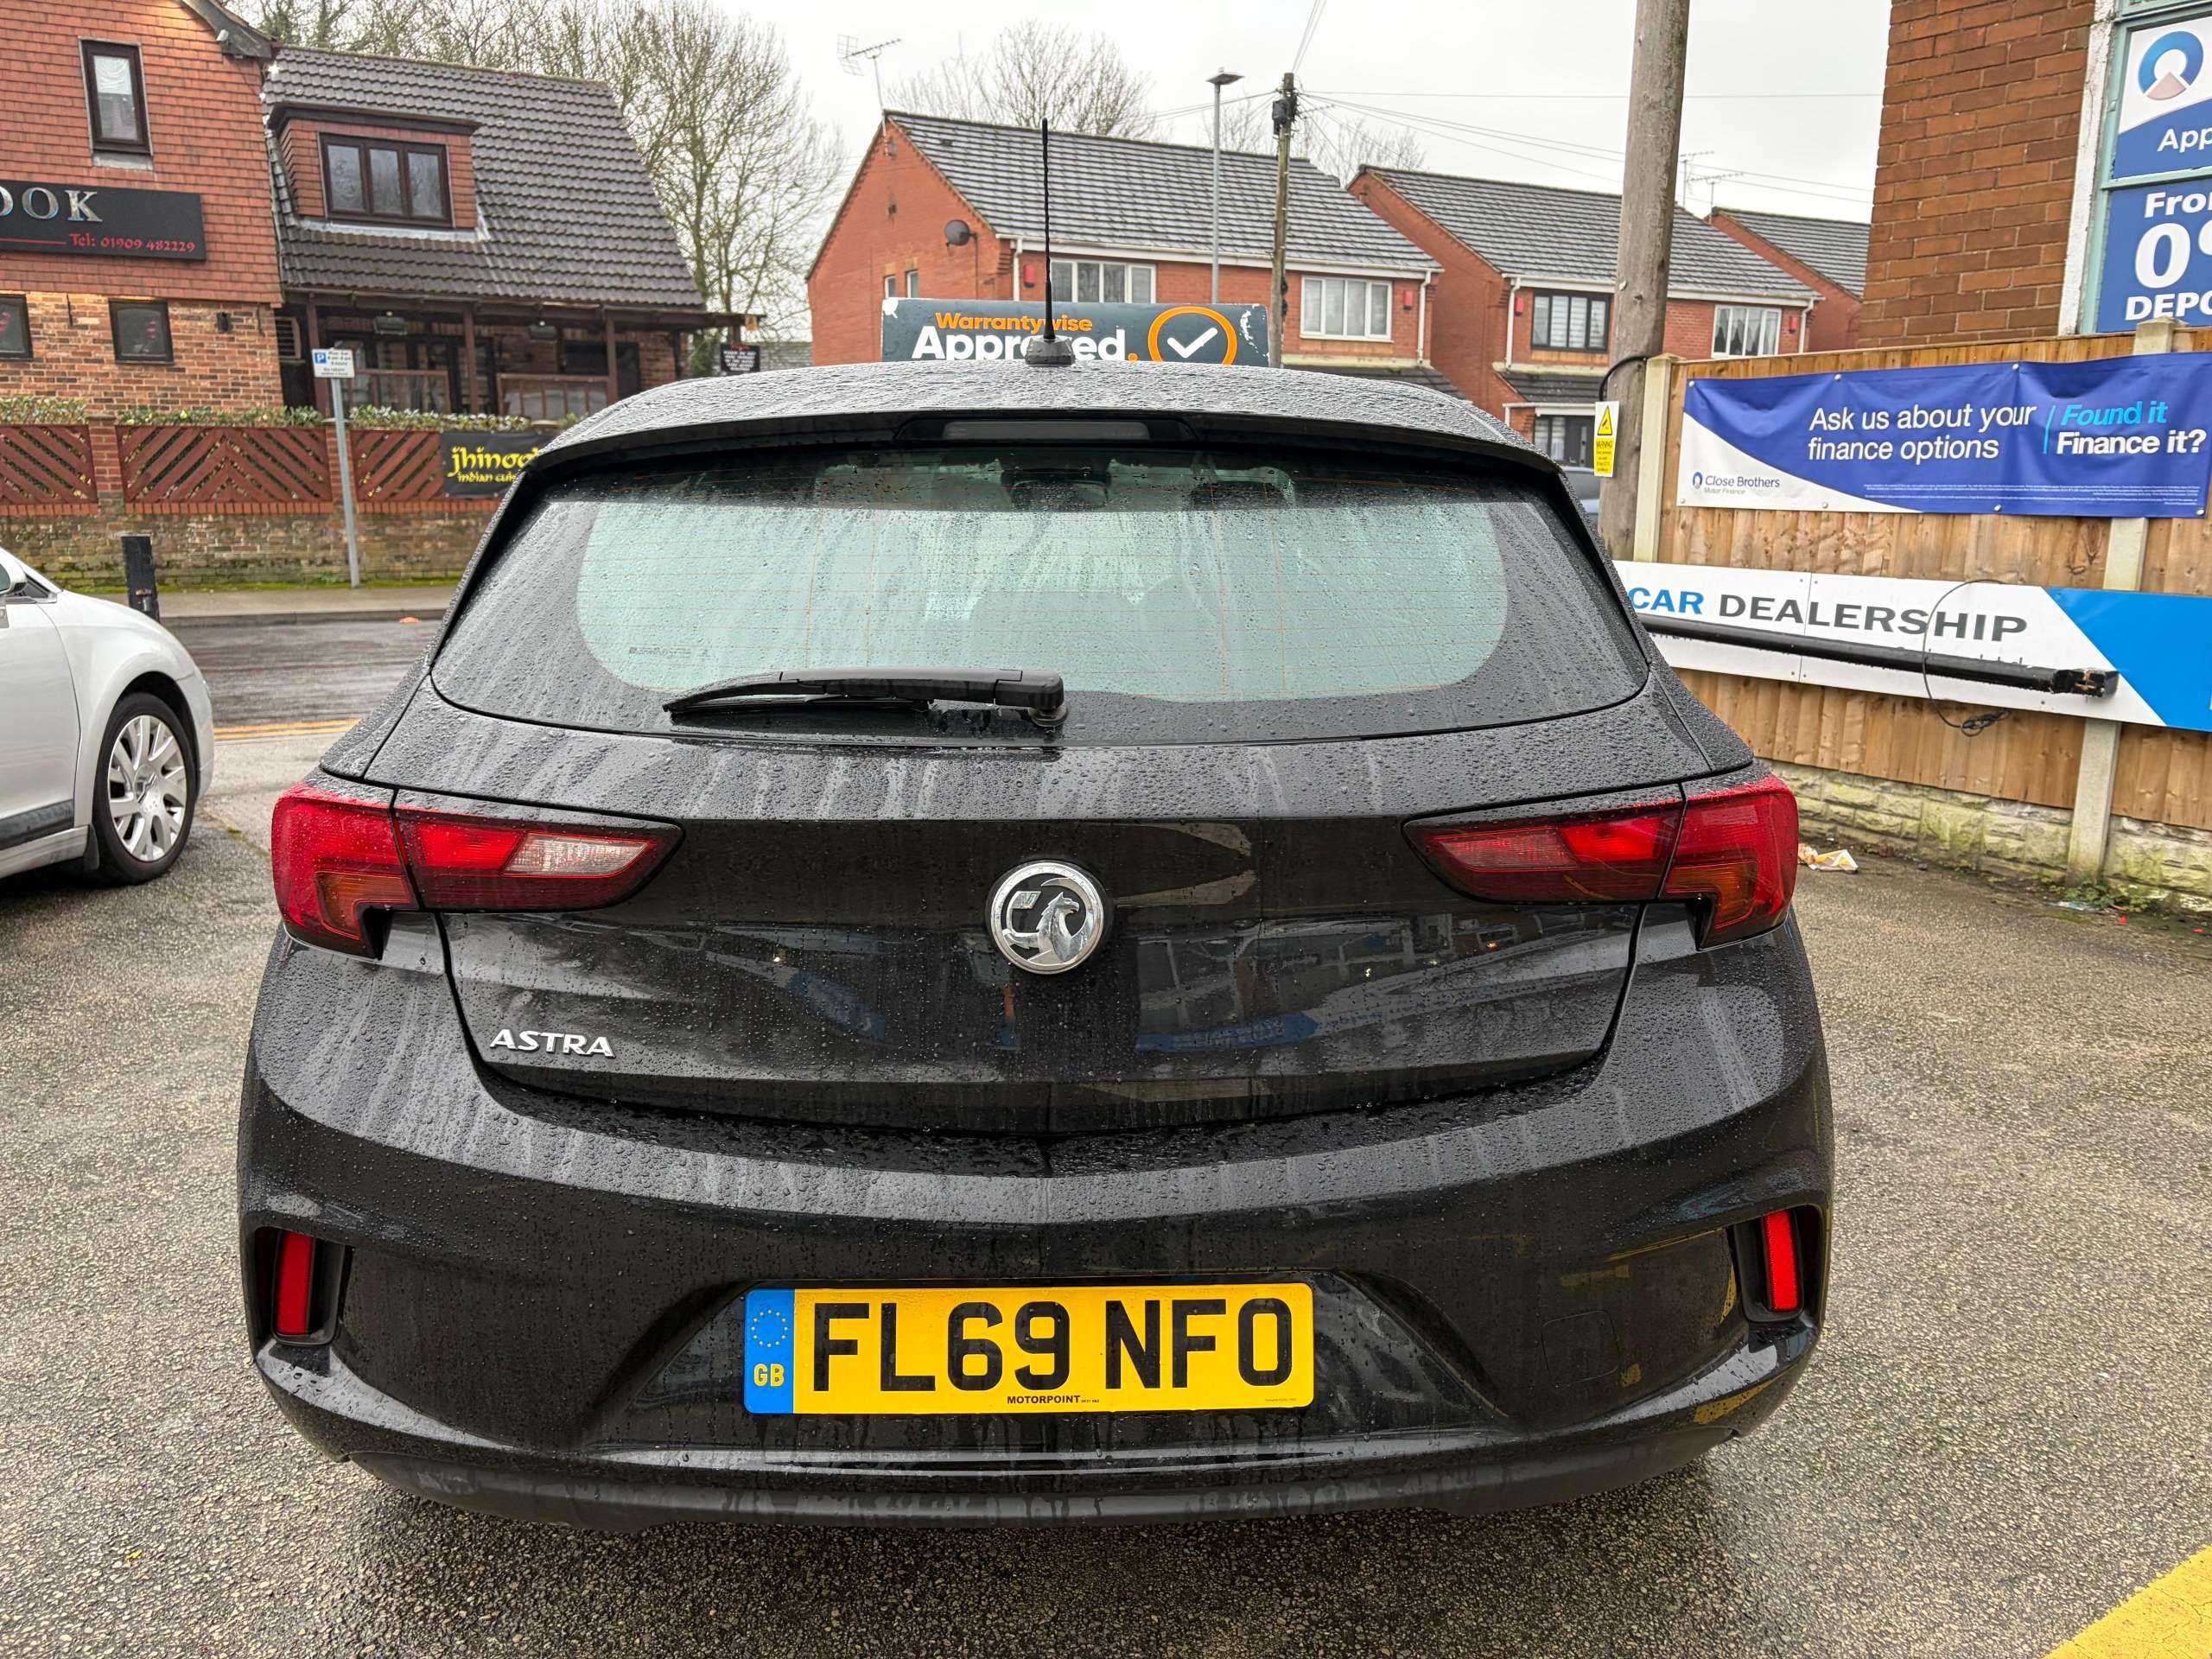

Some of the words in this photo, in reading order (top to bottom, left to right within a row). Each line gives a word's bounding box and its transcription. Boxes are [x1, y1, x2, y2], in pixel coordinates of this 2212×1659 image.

[2145, 191, 2212, 219] Fro
[69, 232, 95, 248] Tel:
[100, 237, 143, 250] 01909
[146, 238, 196, 253] 482229
[2135, 219, 2212, 289] 0
[935, 312, 1093, 334] Warrantywise
[912, 325, 1139, 363] Appred.
[1809, 407, 1855, 431] Ask
[1861, 410, 1890, 429] us
[1897, 404, 1973, 429] about
[1978, 404, 2037, 433] your
[2061, 401, 2143, 426] Found
[2148, 400, 2169, 424] it
[1808, 436, 1893, 461] finance
[1900, 435, 2000, 466] options
[2056, 431, 2160, 454] Finance
[2166, 429, 2208, 454] it?
[1705, 475, 1735, 486] Close
[1737, 476, 1780, 488] Brothers
[1628, 587, 1705, 615] CAR
[1719, 593, 2028, 644] DEALERSHIP
[489, 1028, 616, 1058] ASTRA
[813, 1300, 1071, 1392] FL69
[1105, 1296, 1293, 1389] NFO
[753, 1363, 785, 1388] GB
[1007, 1395, 1081, 1404] MOTORPOINT
